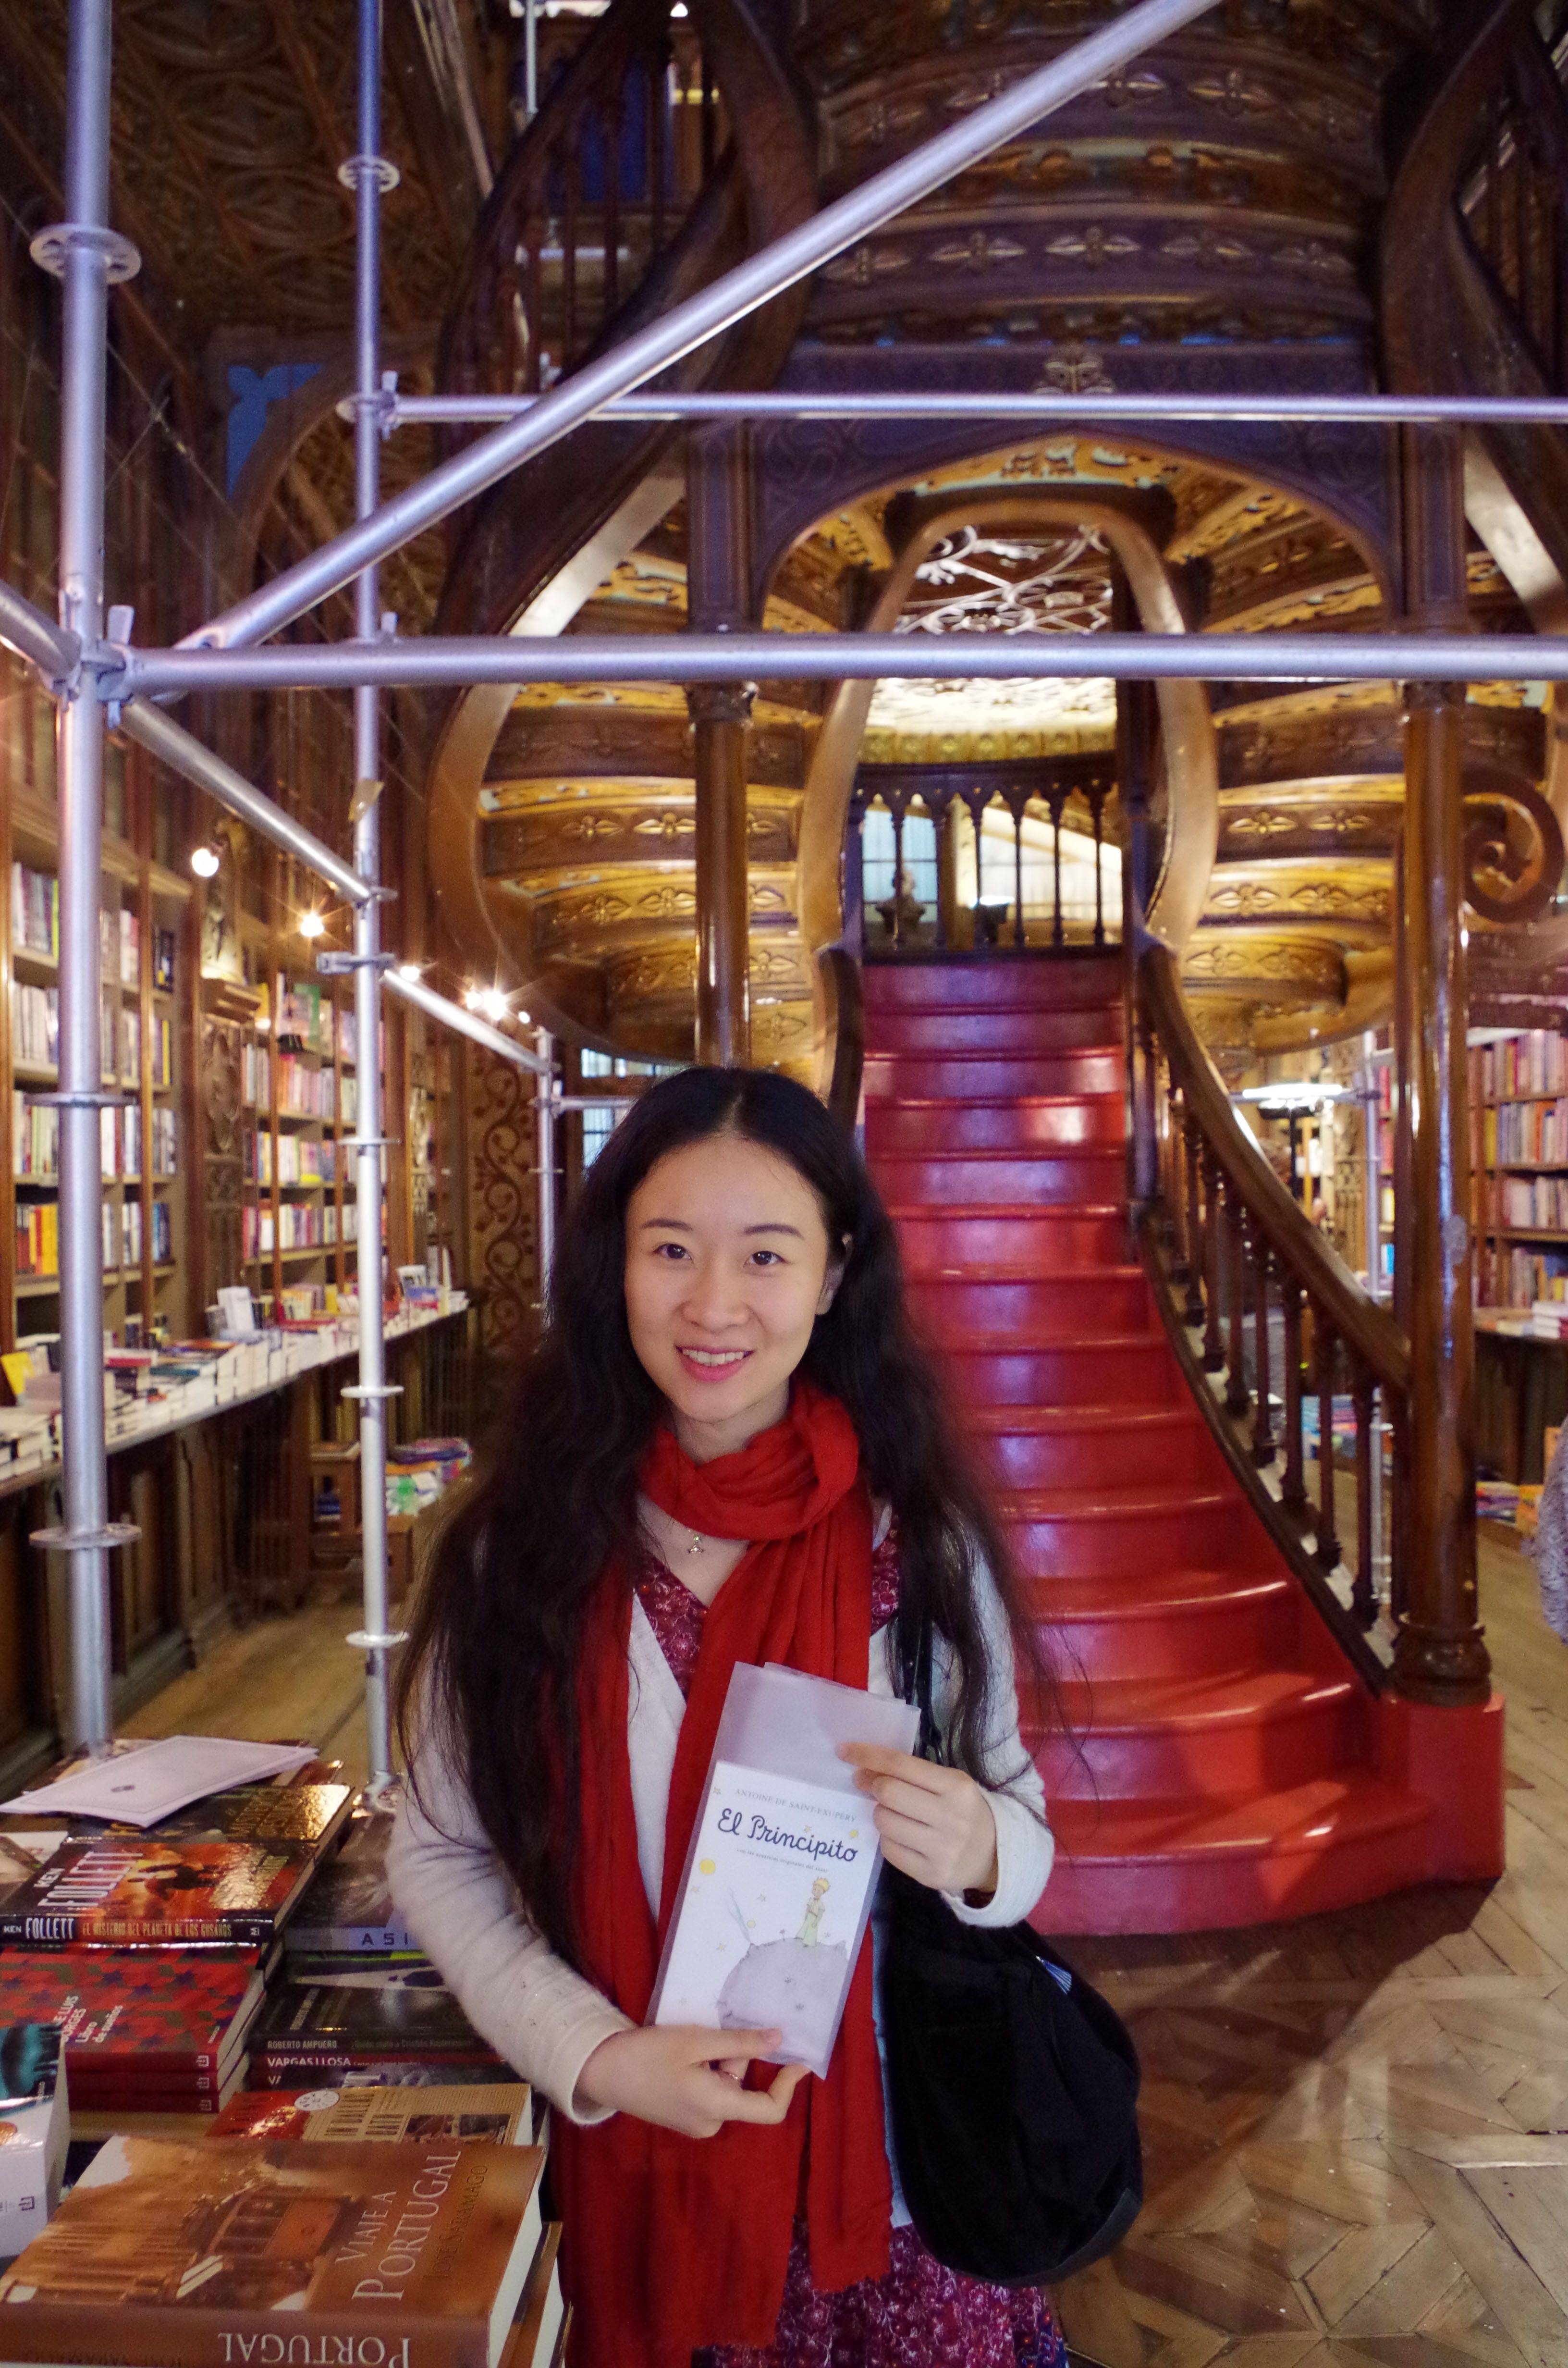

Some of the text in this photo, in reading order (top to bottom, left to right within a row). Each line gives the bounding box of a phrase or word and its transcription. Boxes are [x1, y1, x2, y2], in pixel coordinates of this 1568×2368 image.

[735, 1788, 772, 1802] ANTOINE
[718, 1808, 858, 1861] El Principito
[33, 1868, 65, 1887] KEN
[37, 1850, 143, 1906] FOLLETT
[25, 1917, 74, 1940] FOLLETT
[82, 1923, 91, 1936] EL
[93, 1922, 125, 1936] MISTERIO
[127, 1923, 140, 1936] DEL
[143, 1923, 172, 1936] PLANETA
[174, 1923, 183, 1936] DE
[185, 1924, 198, 1936] LOS
[201, 1924, 232, 1937] GUSANOS
[268, 2040, 337, 2049] ROBERTO AMPUERO
[335, 2191, 397, 2264] VIAJE A
[352, 2151, 462, 2301] PORTUGAL
[218, 2332, 411, 2368] PORTUGAL
